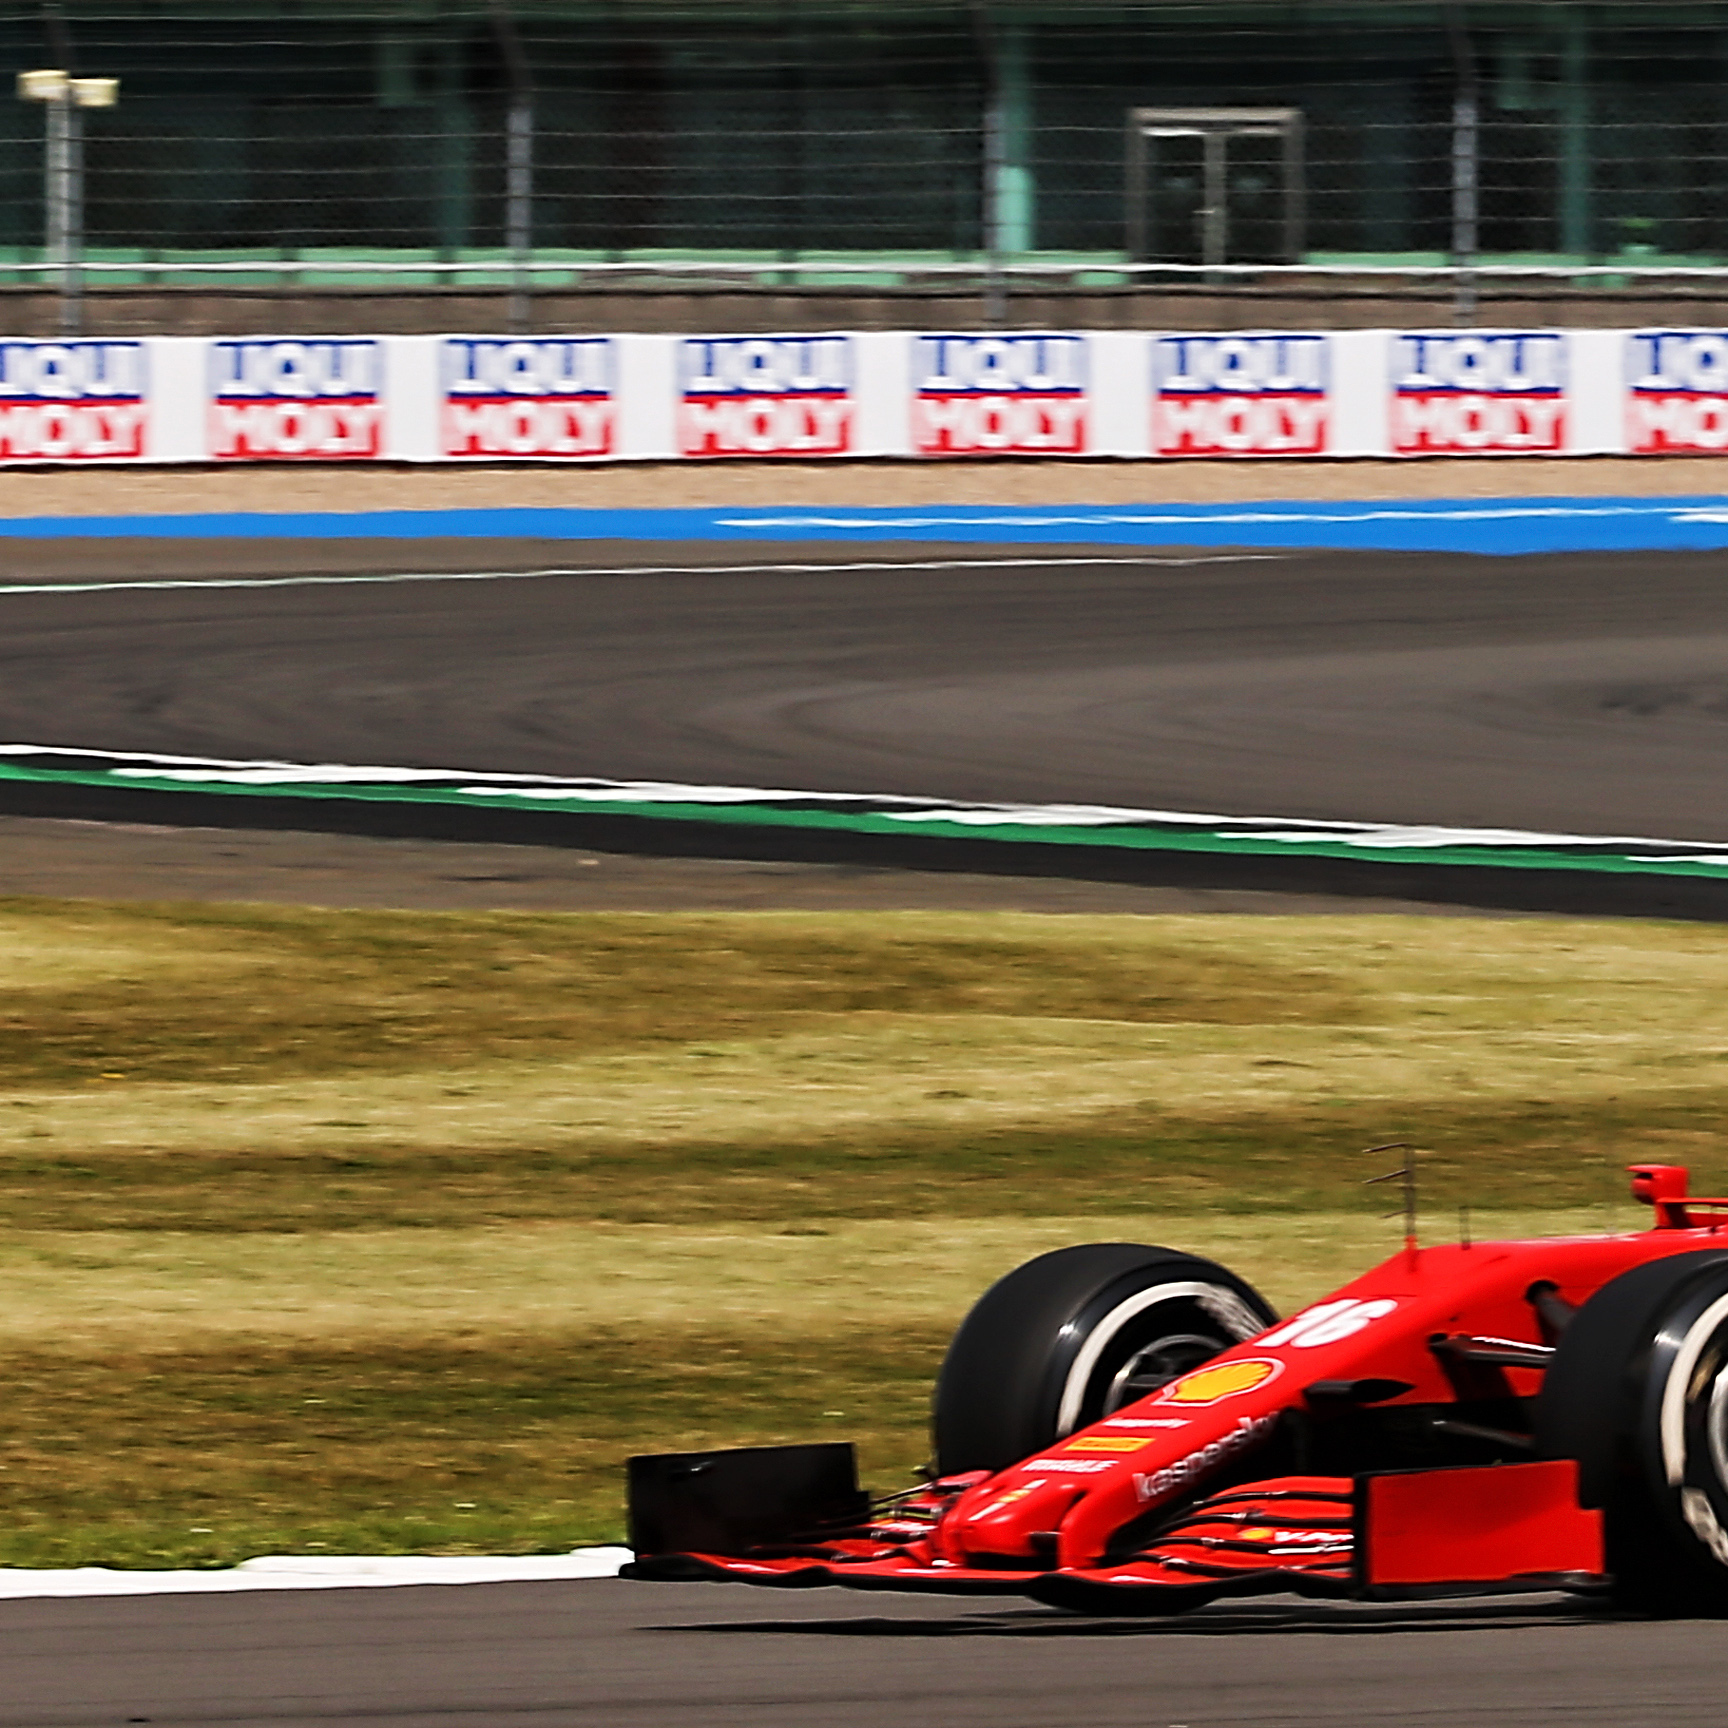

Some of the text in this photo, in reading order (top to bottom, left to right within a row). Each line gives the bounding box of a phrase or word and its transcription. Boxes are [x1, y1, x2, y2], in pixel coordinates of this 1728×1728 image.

[0, 346, 145, 396] IQUI
[212, 344, 380, 395] LIQUI
[444, 343, 614, 393] LIQUI
[680, 341, 851, 392] LIQUI
[916, 339, 1086, 390] LIQUI
[1156, 339, 1328, 390] LIQUI
[1394, 338, 1565, 388] LIQUI
[212, 404, 380, 453] MOLY
[444, 402, 614, 453] MOLY
[680, 400, 851, 451] MOLY
[916, 398, 1086, 448] MOLY
[1156, 398, 1328, 449] MOLY
[1394, 397, 1565, 447] MOLY
[1254, 1298, 1398, 1348] 16
